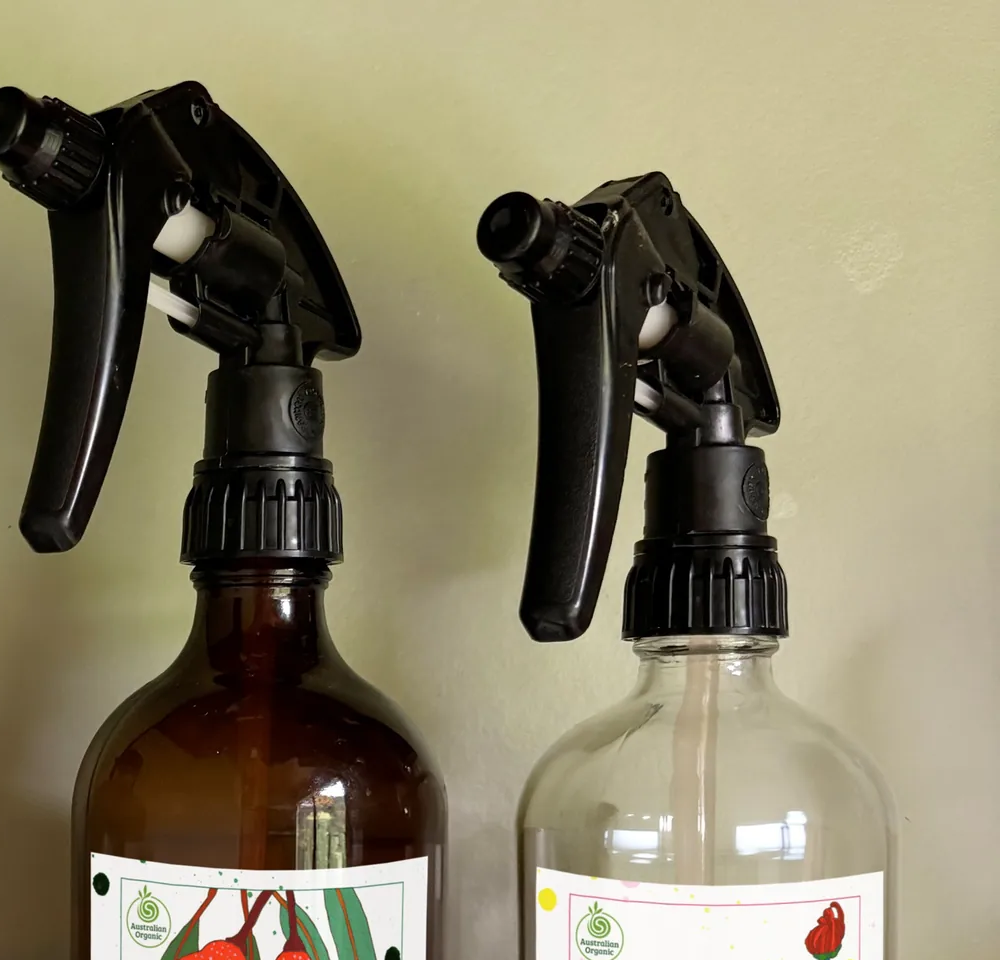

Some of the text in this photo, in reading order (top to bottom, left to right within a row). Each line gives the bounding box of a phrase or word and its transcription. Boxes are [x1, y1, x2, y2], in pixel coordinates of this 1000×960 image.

[130, 923, 167, 932] Australian
[135, 931, 162, 940] Organic
[580, 938, 619, 948] Australian
[585, 946, 614, 956] Organic
